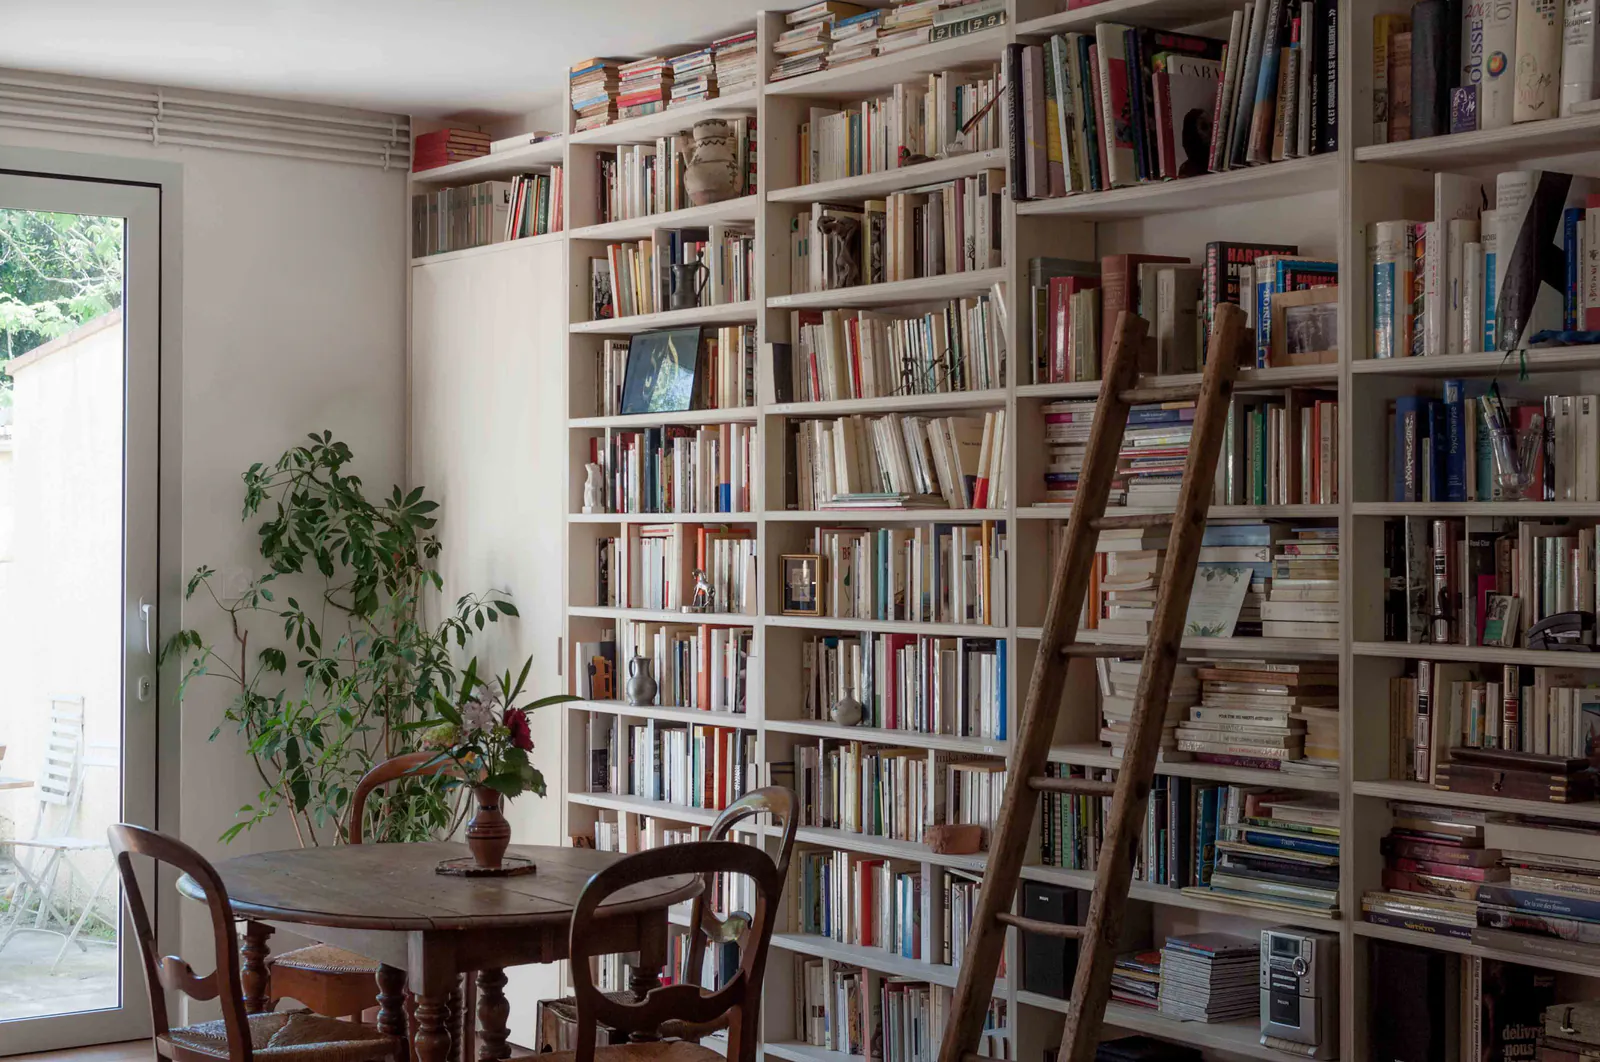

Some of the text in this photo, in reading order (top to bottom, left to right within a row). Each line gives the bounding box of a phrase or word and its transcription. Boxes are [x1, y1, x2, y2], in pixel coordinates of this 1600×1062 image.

[1470, 19, 1483, 84] OUSSE
[1227, 247, 1292, 263] HARR
[1262, 289, 1270, 331] JUNIOR
[1502, 1022, 1544, 1040] délivre
